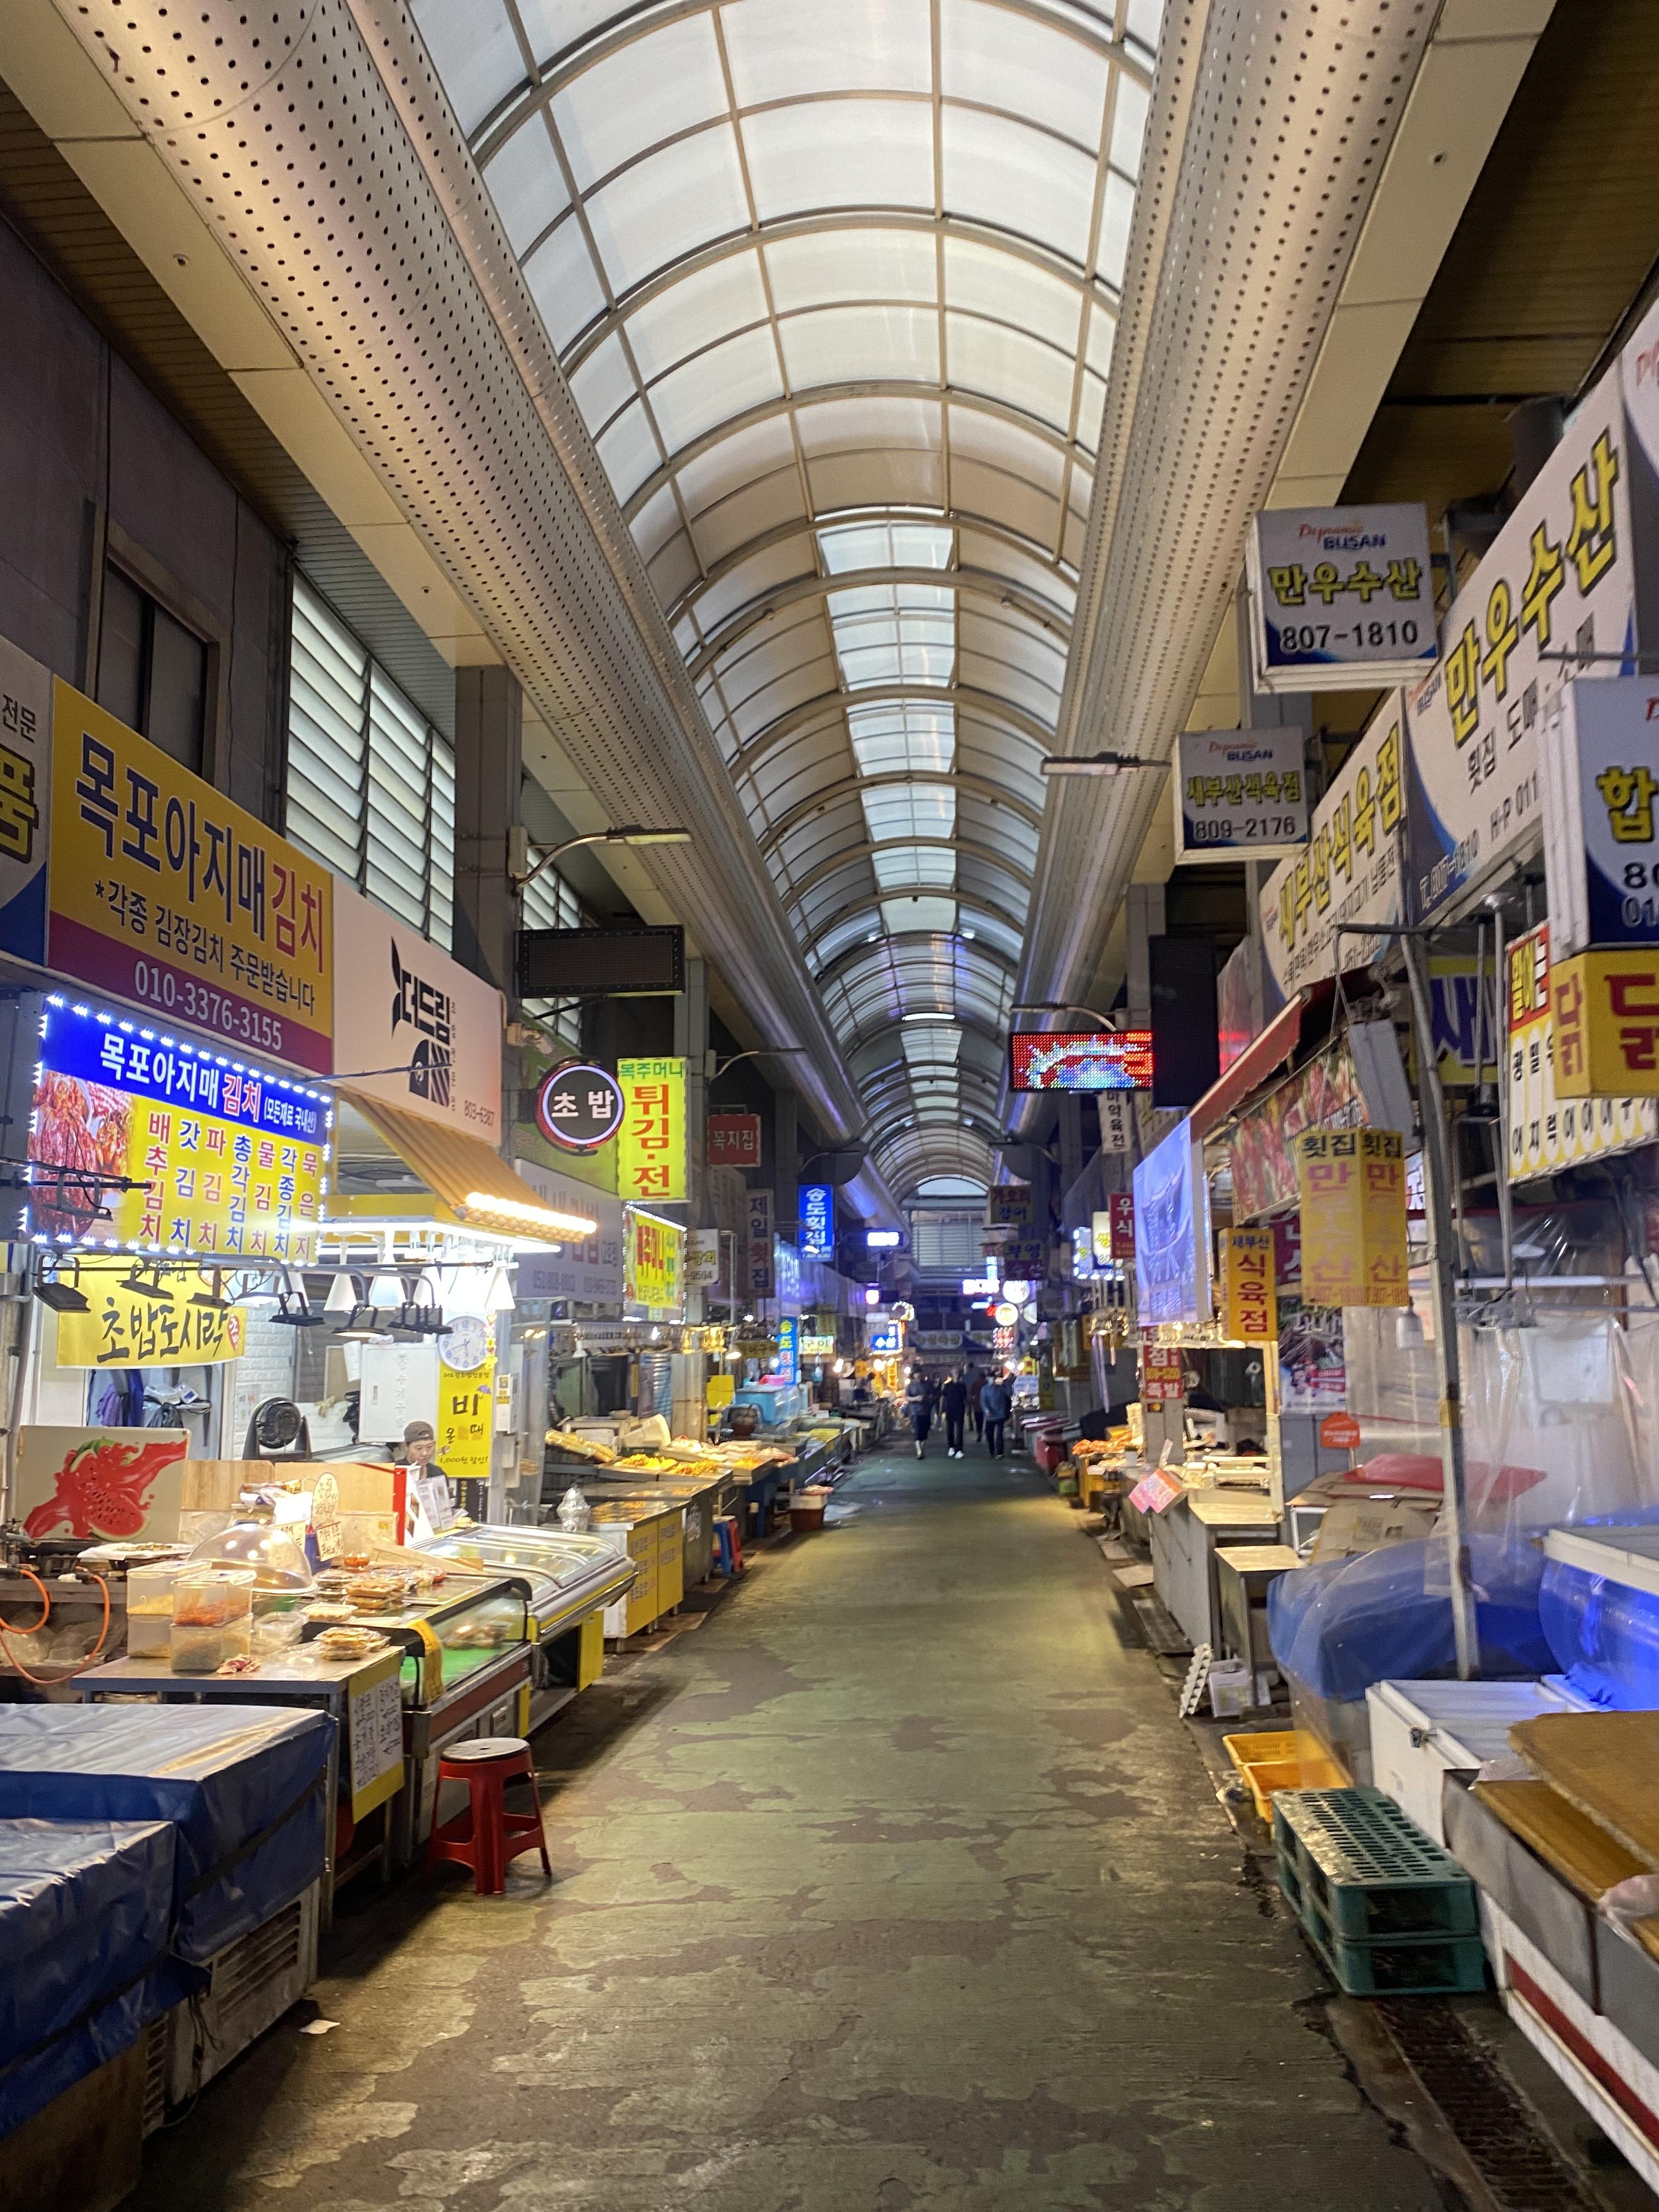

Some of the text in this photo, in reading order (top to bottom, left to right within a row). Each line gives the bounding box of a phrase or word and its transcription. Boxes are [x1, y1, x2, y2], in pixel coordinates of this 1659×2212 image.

[1323, 533, 1386, 551] BUSAN
[1268, 557, 1423, 607] 만우수산
[1445, 425, 1618, 749] 만우수산
[1280, 619, 1419, 652] 807-1810
[2, 693, 36, 743] 전문
[1227, 749, 1273, 761] BUSAN
[1468, 727, 1497, 794] 횟집
[1194, 816, 1296, 840] 809-2176
[155, 906, 224, 974] 김장김치
[230, 946, 315, 1017] 주문받습니다
[134, 960, 283, 1051] 010-3376-3155
[550, 1089, 615, 1119] 초밥
[139, 1111, 172, 1245] 배추김치
[1302, 1132, 1357, 1159] 횟집
[1362, 1133, 1403, 1160] 횟집
[171, 1118, 201, 1248] 갓김치
[198, 1125, 228, 1252] 파김치
[225, 1133, 252, 1256] 총각김치
[250, 1141, 275, 1257] 물김치
[273, 1147, 298, 1259] 각종김치
[295, 1151, 319, 1261] 묵은지
[805, 1187, 827, 1245] 송도횟집
[1236, 1253, 1269, 1334] 식육점
[97, 1296, 229, 1364] 초밥도시락
[779, 1319, 794, 1383] 송도횟집
[445, 1423, 484, 1444] 올 때
[453, 1393, 478, 1417] 비
